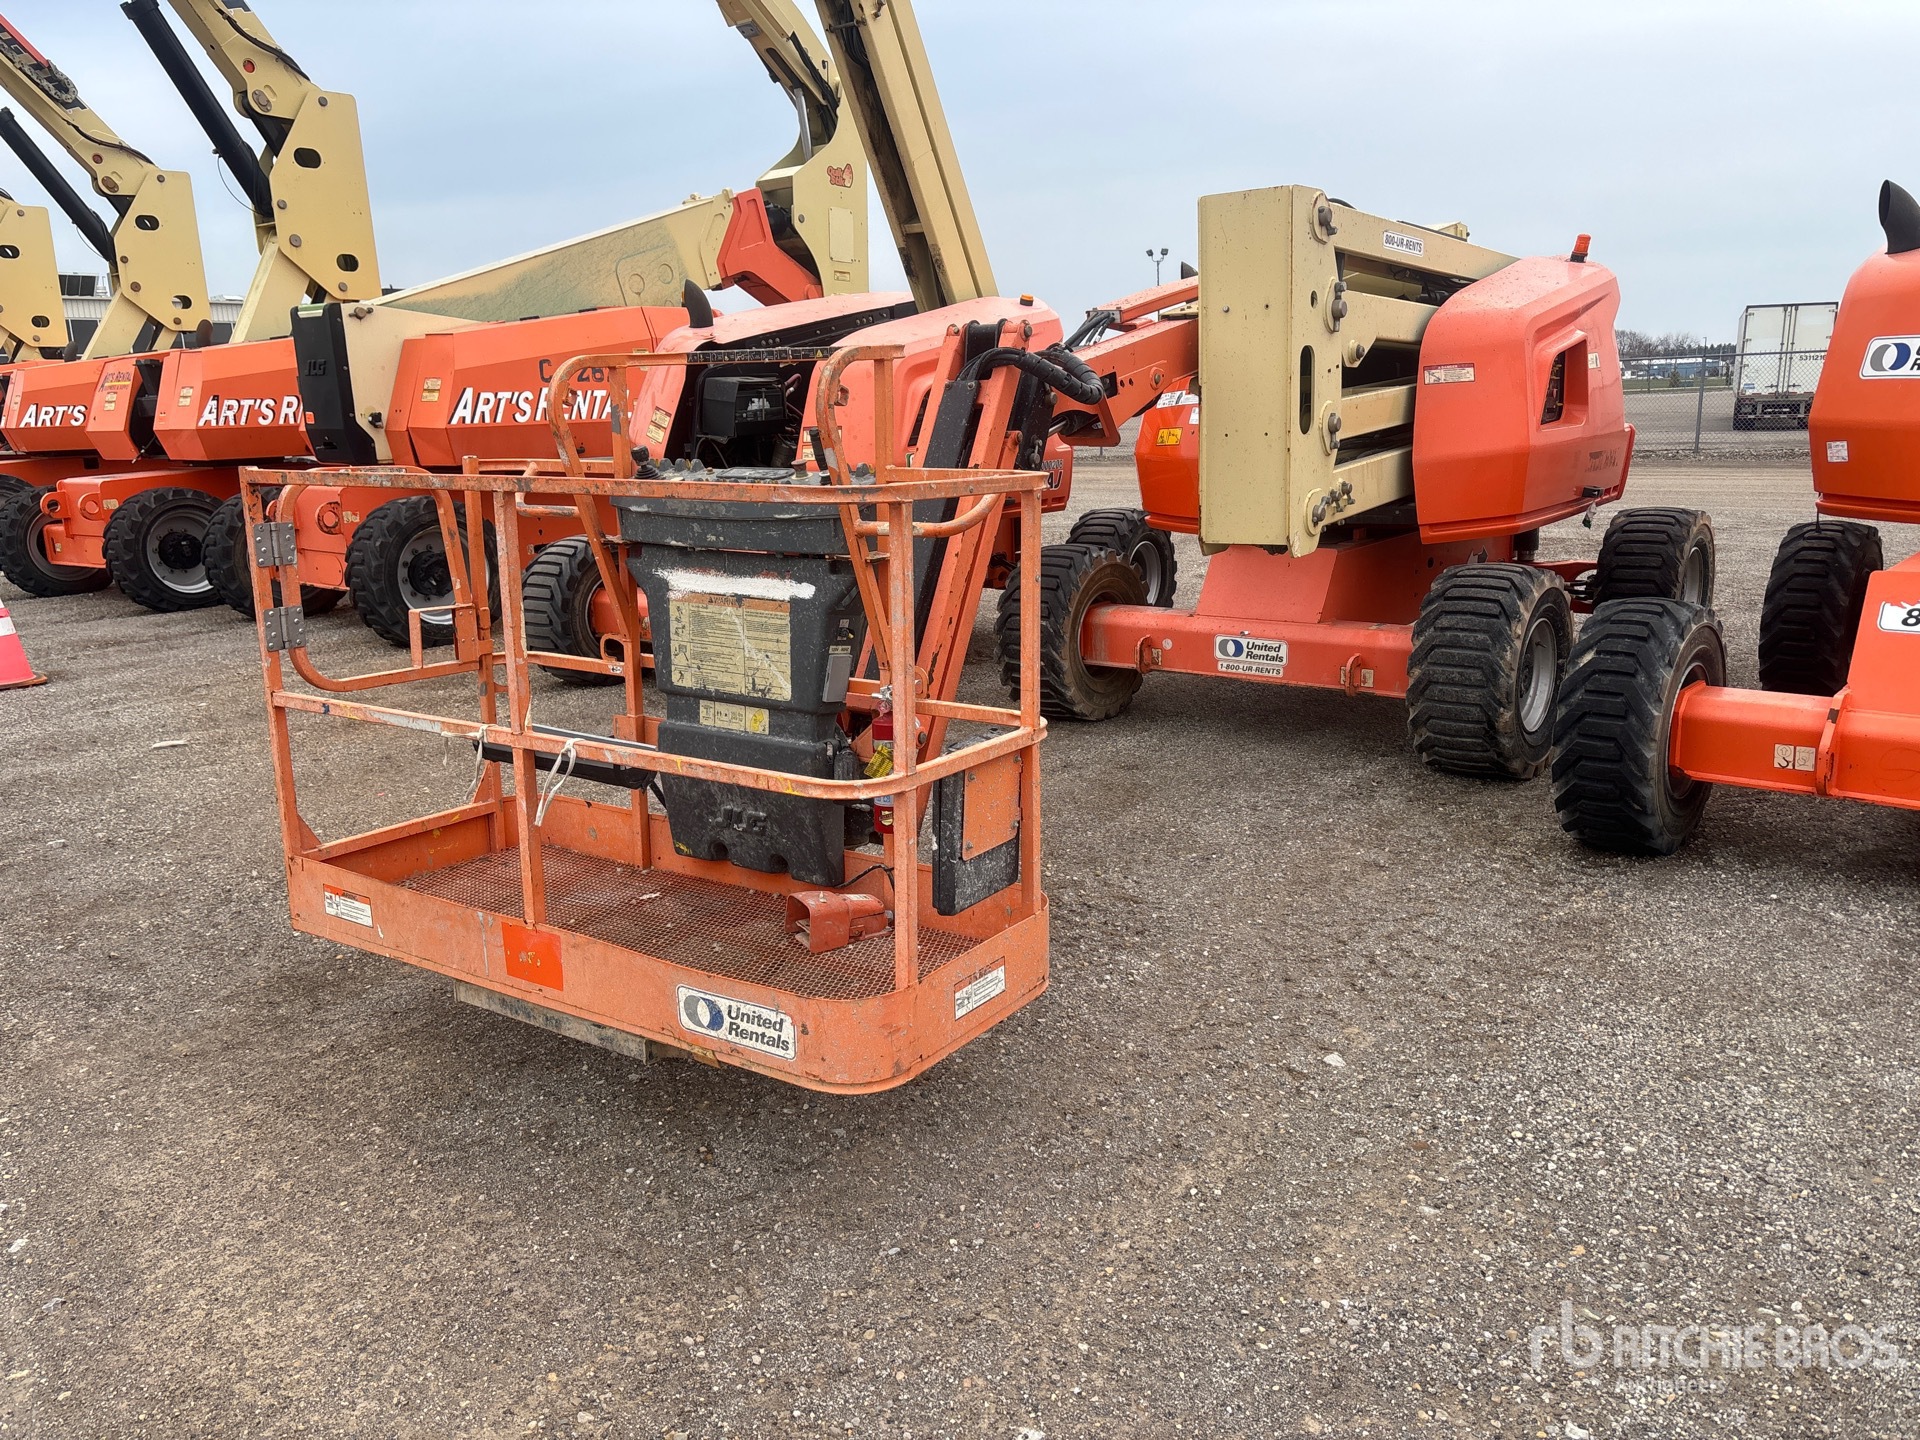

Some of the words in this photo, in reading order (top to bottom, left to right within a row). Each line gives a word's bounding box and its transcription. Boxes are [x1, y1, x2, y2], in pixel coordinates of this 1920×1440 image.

[304, 359, 326, 377] JLG
[19, 402, 88, 428] ART'S
[198, 395, 277, 427] ART'S
[449, 387, 533, 425] ART'S
[1245, 651, 1284, 663] Rentals
[1246, 641, 1282, 653] United
[1219, 663, 1281, 676] 1-800-UR-RENTS
[727, 1004, 784, 1033] United
[728, 1021, 790, 1052] Rentals
